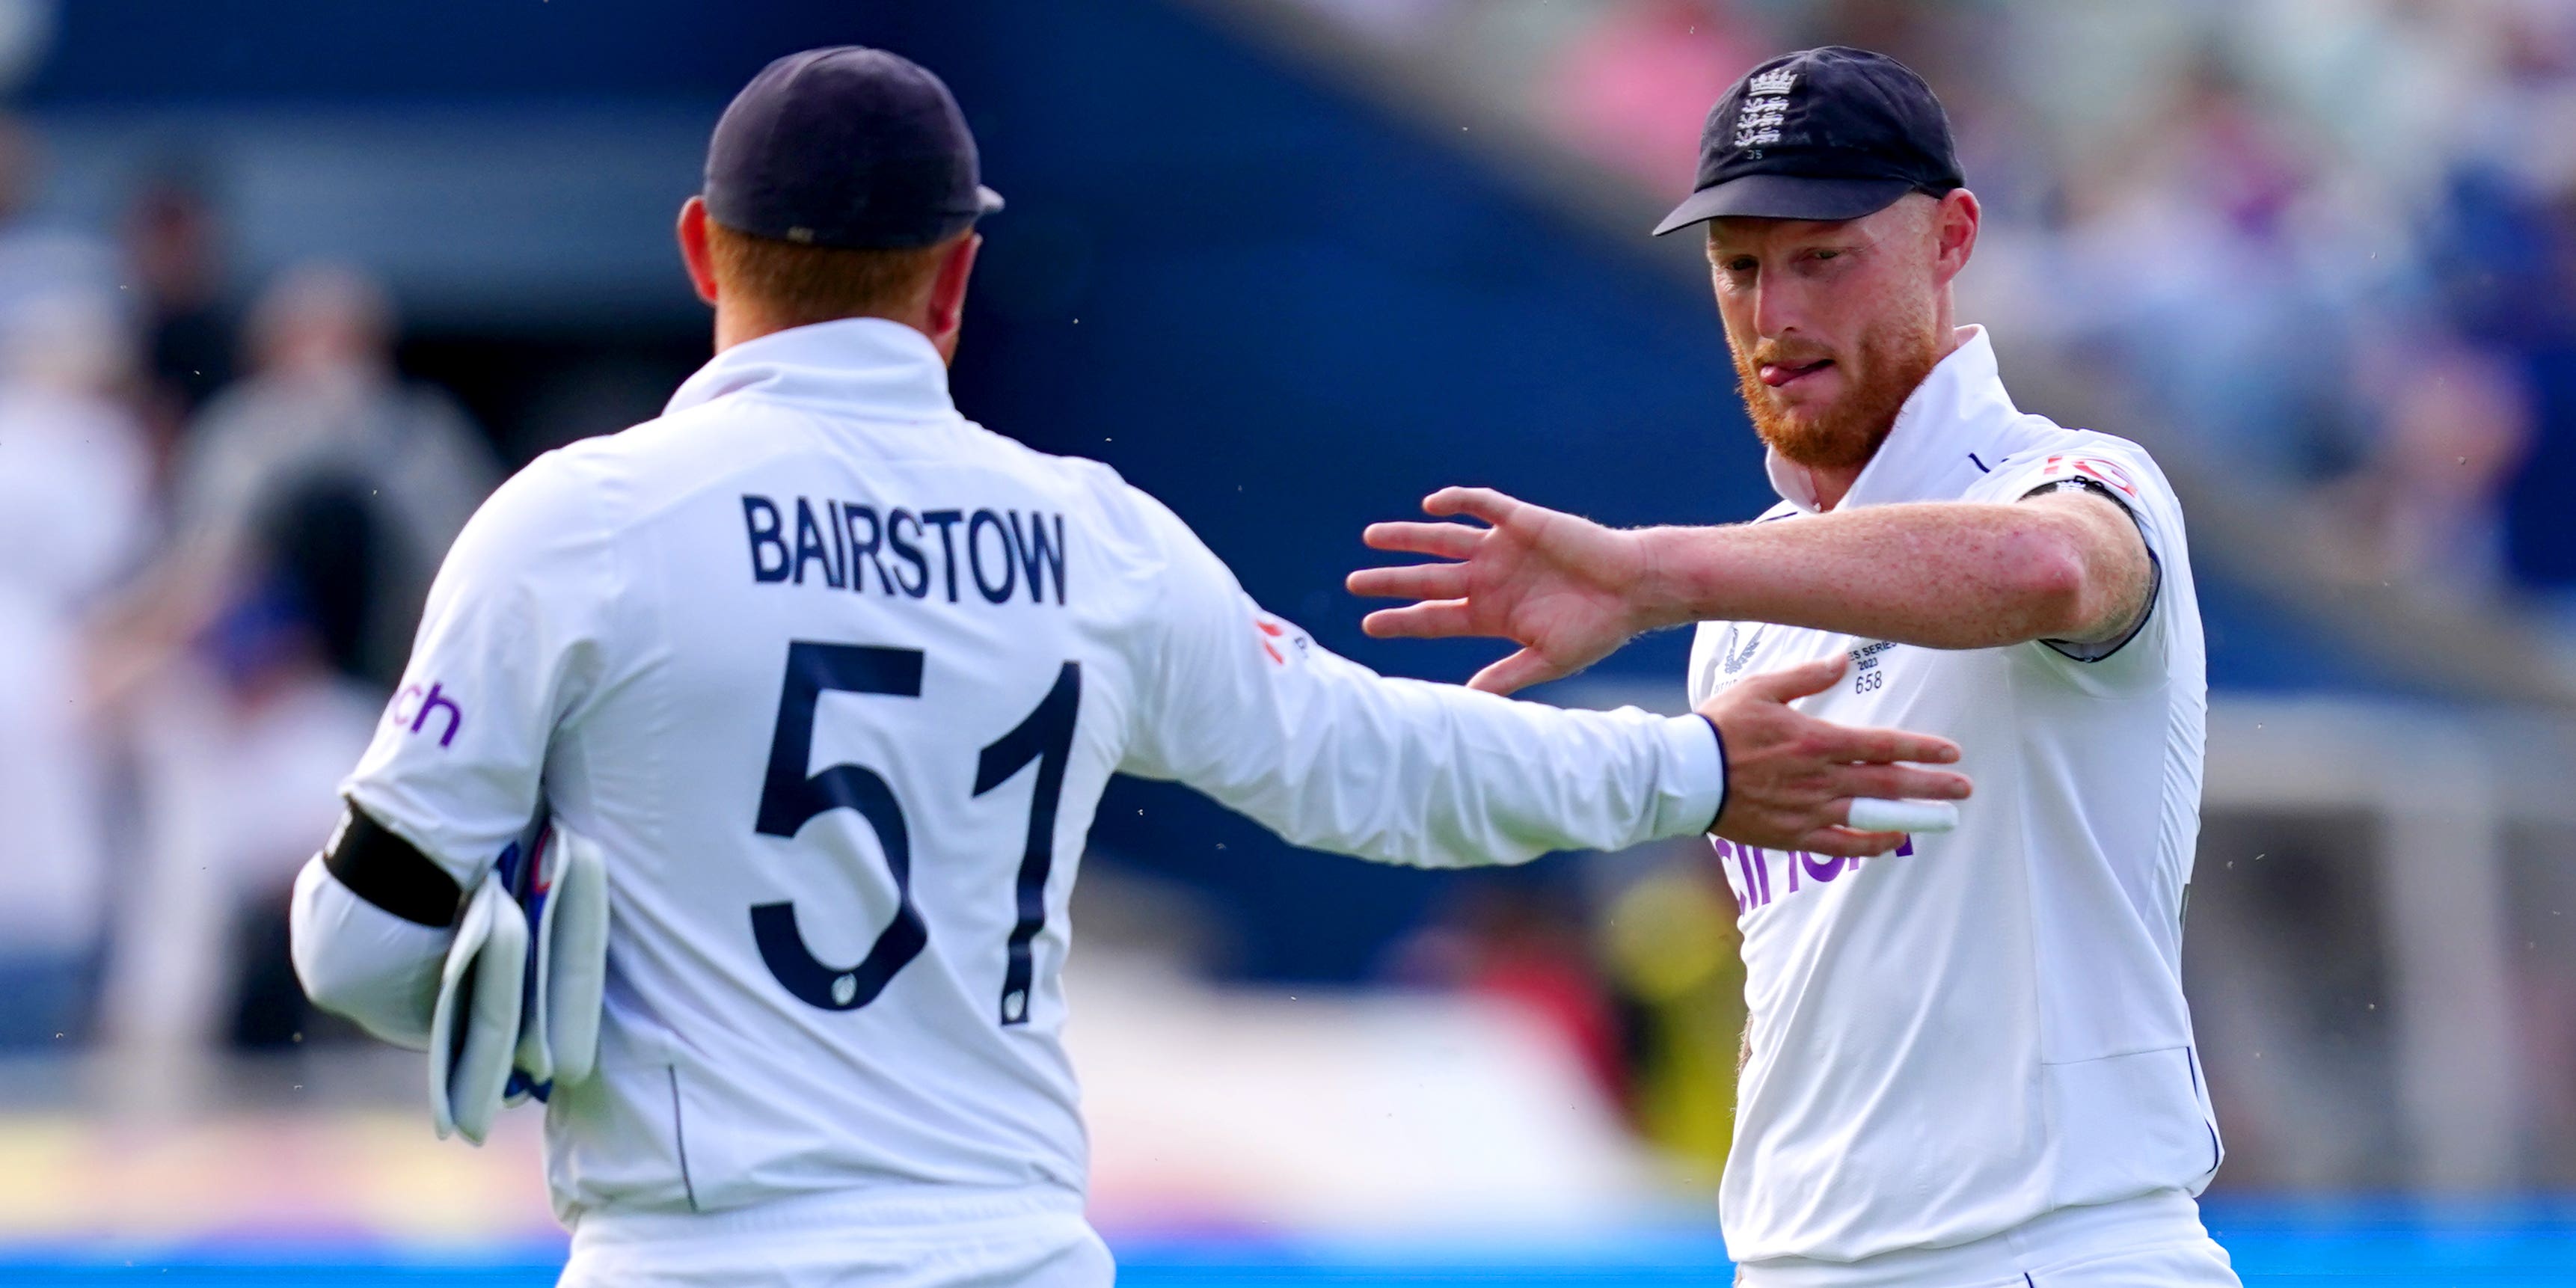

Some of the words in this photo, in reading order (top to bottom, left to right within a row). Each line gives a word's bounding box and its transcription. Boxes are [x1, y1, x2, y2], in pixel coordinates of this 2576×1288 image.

[741, 494, 1067, 607] BAIRSTOW
[1856, 670, 1883, 695] 658
[1857, 657, 1879, 671] 2023
[750, 640, 1082, 1025] 51
